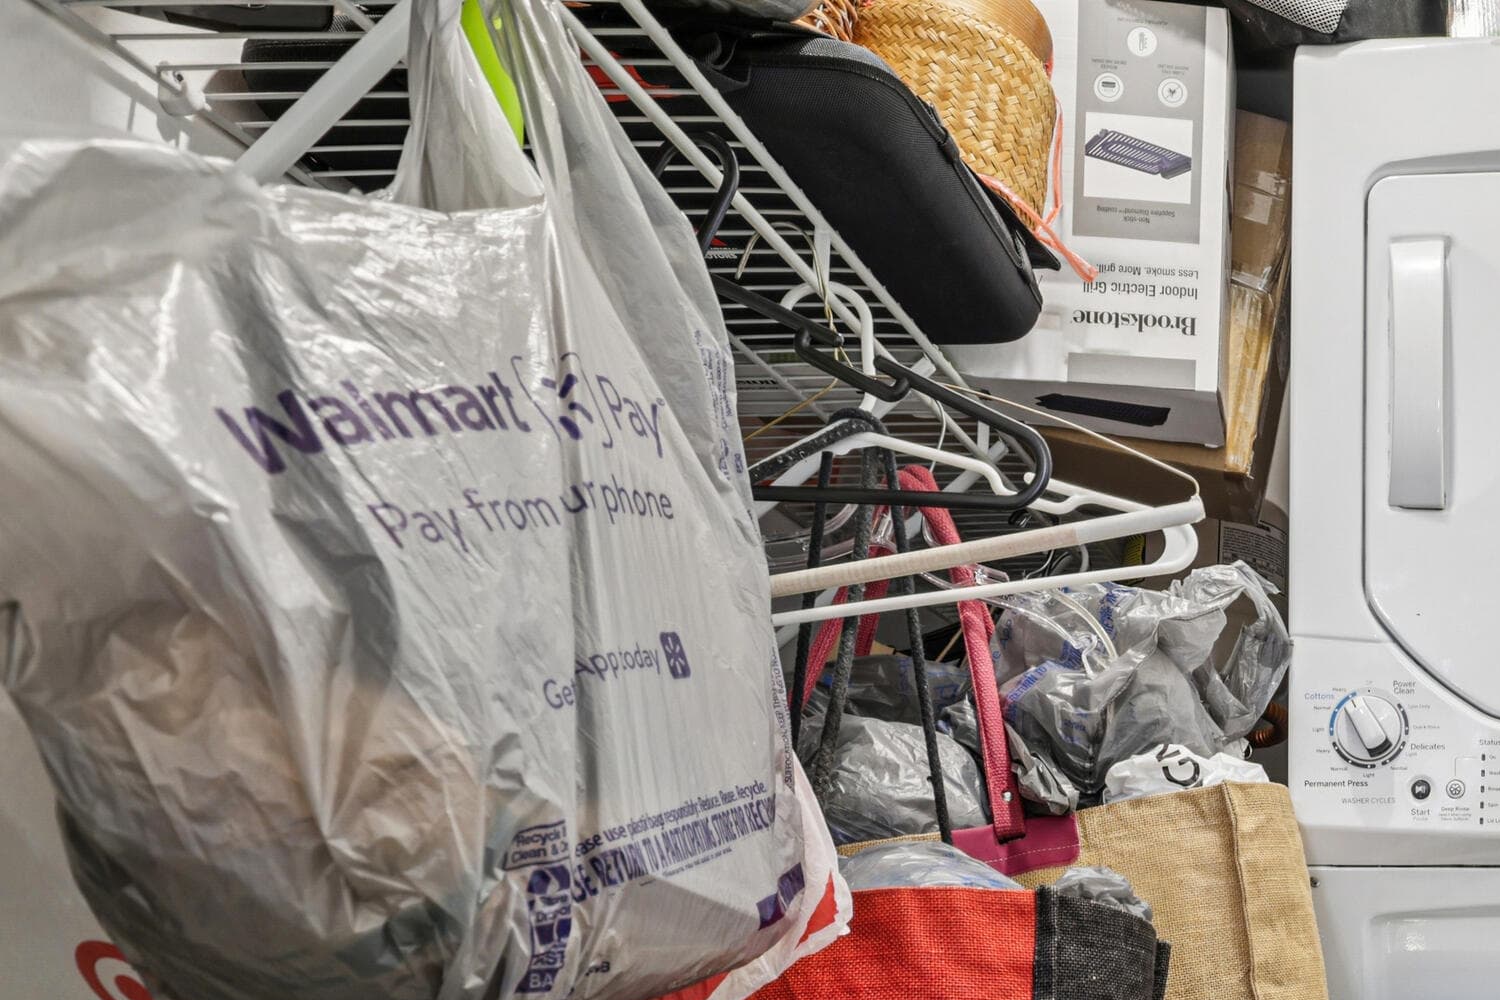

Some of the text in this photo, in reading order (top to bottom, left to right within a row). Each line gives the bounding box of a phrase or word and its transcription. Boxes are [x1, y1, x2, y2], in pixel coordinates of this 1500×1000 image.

[1096, 262, 1199, 280] Less smoke. More grill.
[1083, 280, 1198, 300] Indoor Electric Grill
[1072, 309, 1197, 336] Brookstone
[367, 501, 470, 553] Pay
[463, 487, 560, 533] from
[601, 473, 674, 525] phone
[1392, 680, 1416, 688] Power
[1393, 687, 1415, 695] Clean
[1304, 692, 1334, 700] Cottons
[1410, 743, 1446, 751] Delicates
[1304, 780, 1368, 788] Permanent Press
[1341, 797, 1396, 805] WASHER CYCLES
[1410, 808, 1430, 816] Start
[603, 824, 628, 843] use
[590, 842, 648, 888] RETURN
